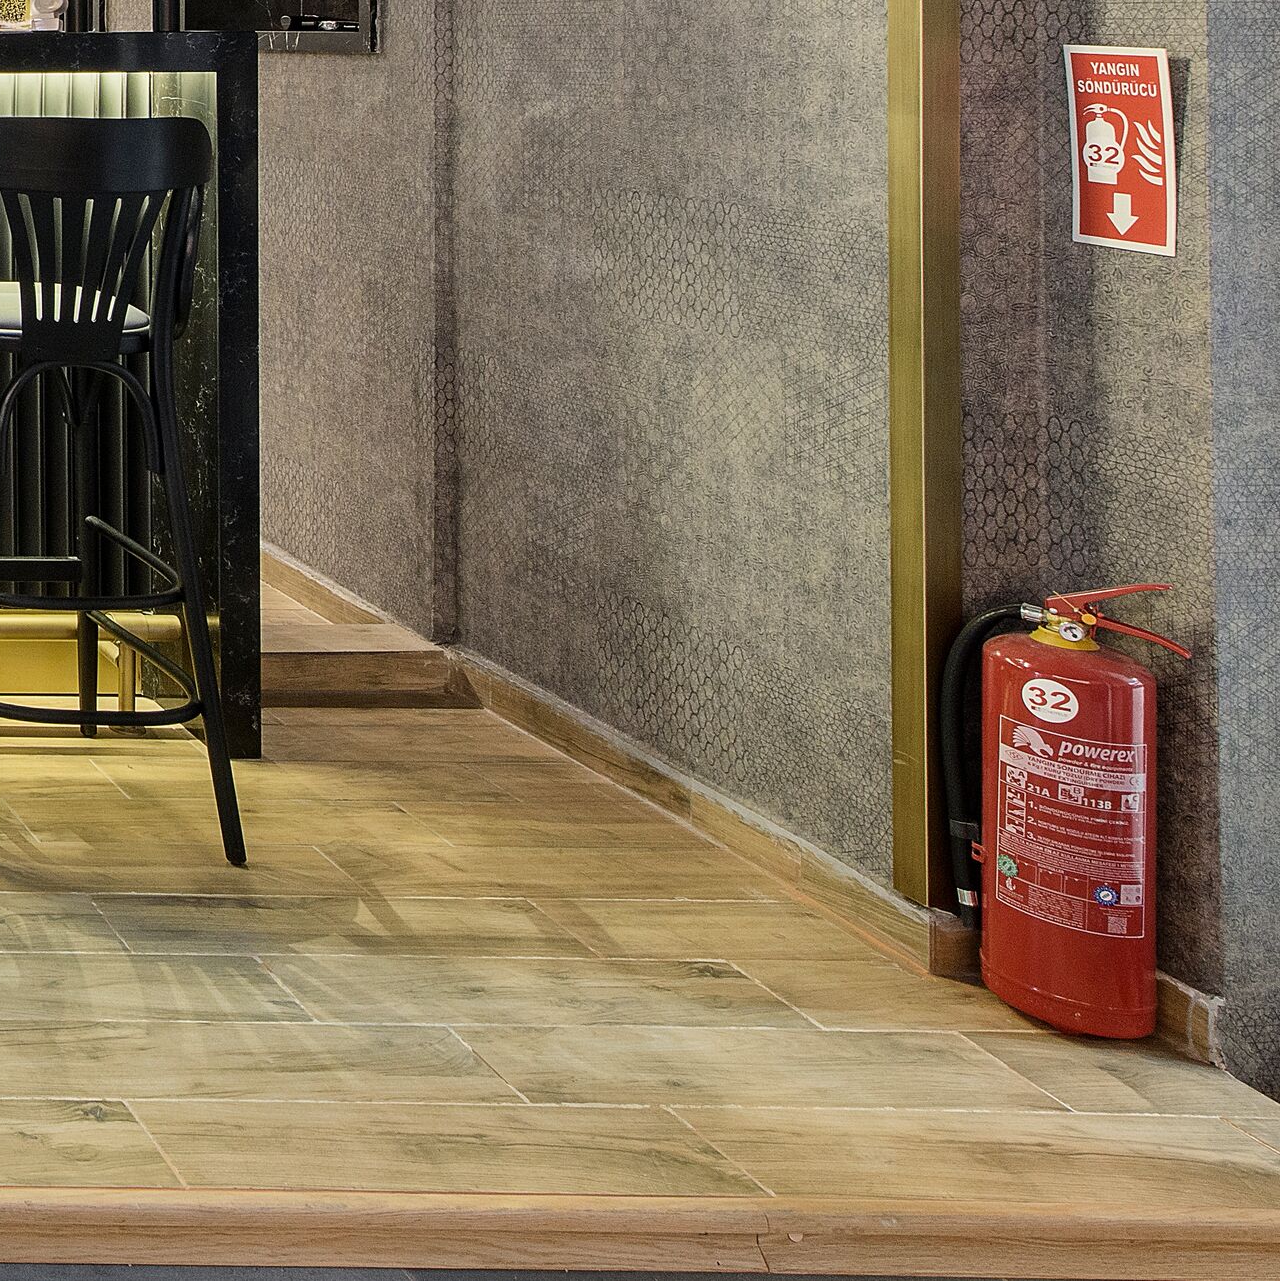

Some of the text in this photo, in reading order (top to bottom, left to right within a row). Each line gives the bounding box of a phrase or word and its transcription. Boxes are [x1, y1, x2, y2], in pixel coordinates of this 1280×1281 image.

[1090, 61, 1140, 77] YANGIN
[1077, 78, 1158, 97] SÖNDÜRÜCÜ
[1088, 144, 1119, 165] 32
[1028, 686, 1071, 712] 32
[1058, 741, 1135, 762] powerex
[1027, 755, 1056, 768] YANGIN
[1027, 783, 1050, 798] 21A
[1073, 786, 1081, 795] B
[1028, 800, 1038, 810] 1.
[1083, 797, 1112, 810] 113B
[1027, 816, 1037, 826] 2.
[1026, 831, 1037, 841] 3.
